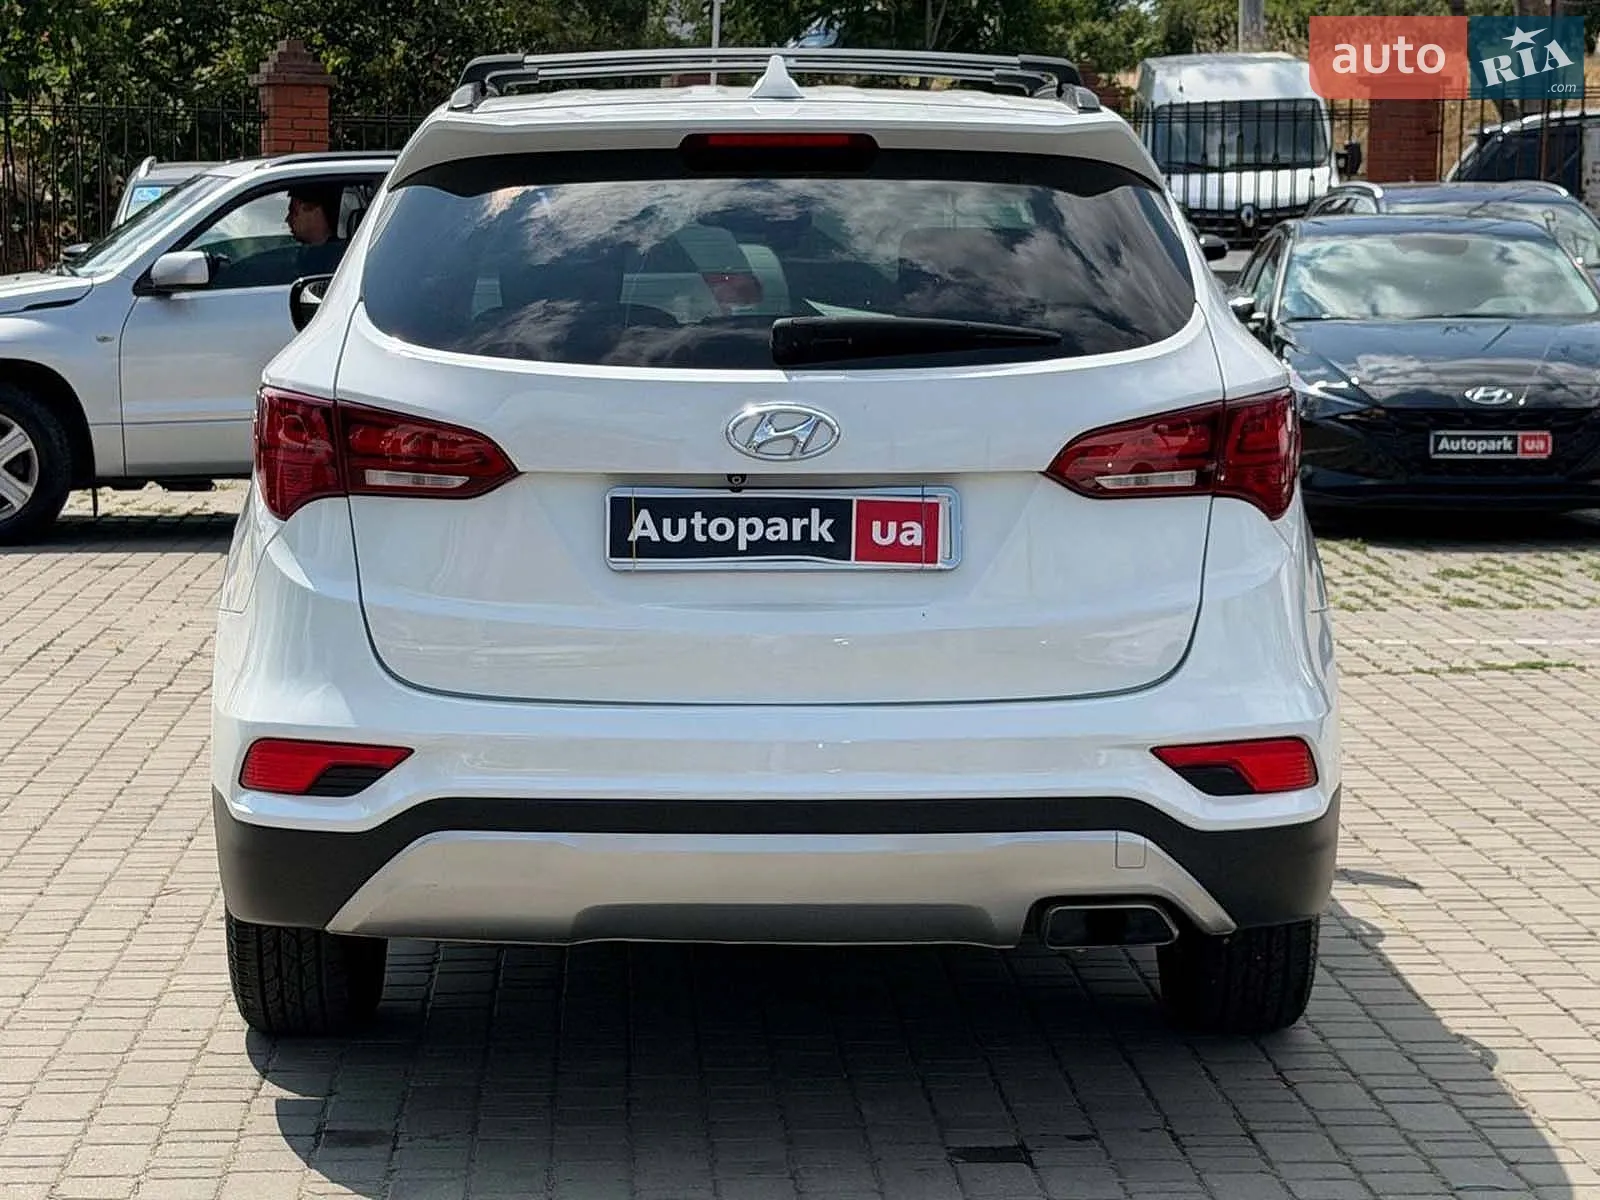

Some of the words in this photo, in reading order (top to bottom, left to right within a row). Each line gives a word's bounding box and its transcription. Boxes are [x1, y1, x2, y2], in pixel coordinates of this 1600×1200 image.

[1438, 436, 1513, 453] Autopark
[1524, 438, 1545, 450] ua
[628, 508, 835, 550] Autopark
[871, 519, 923, 546] ua
